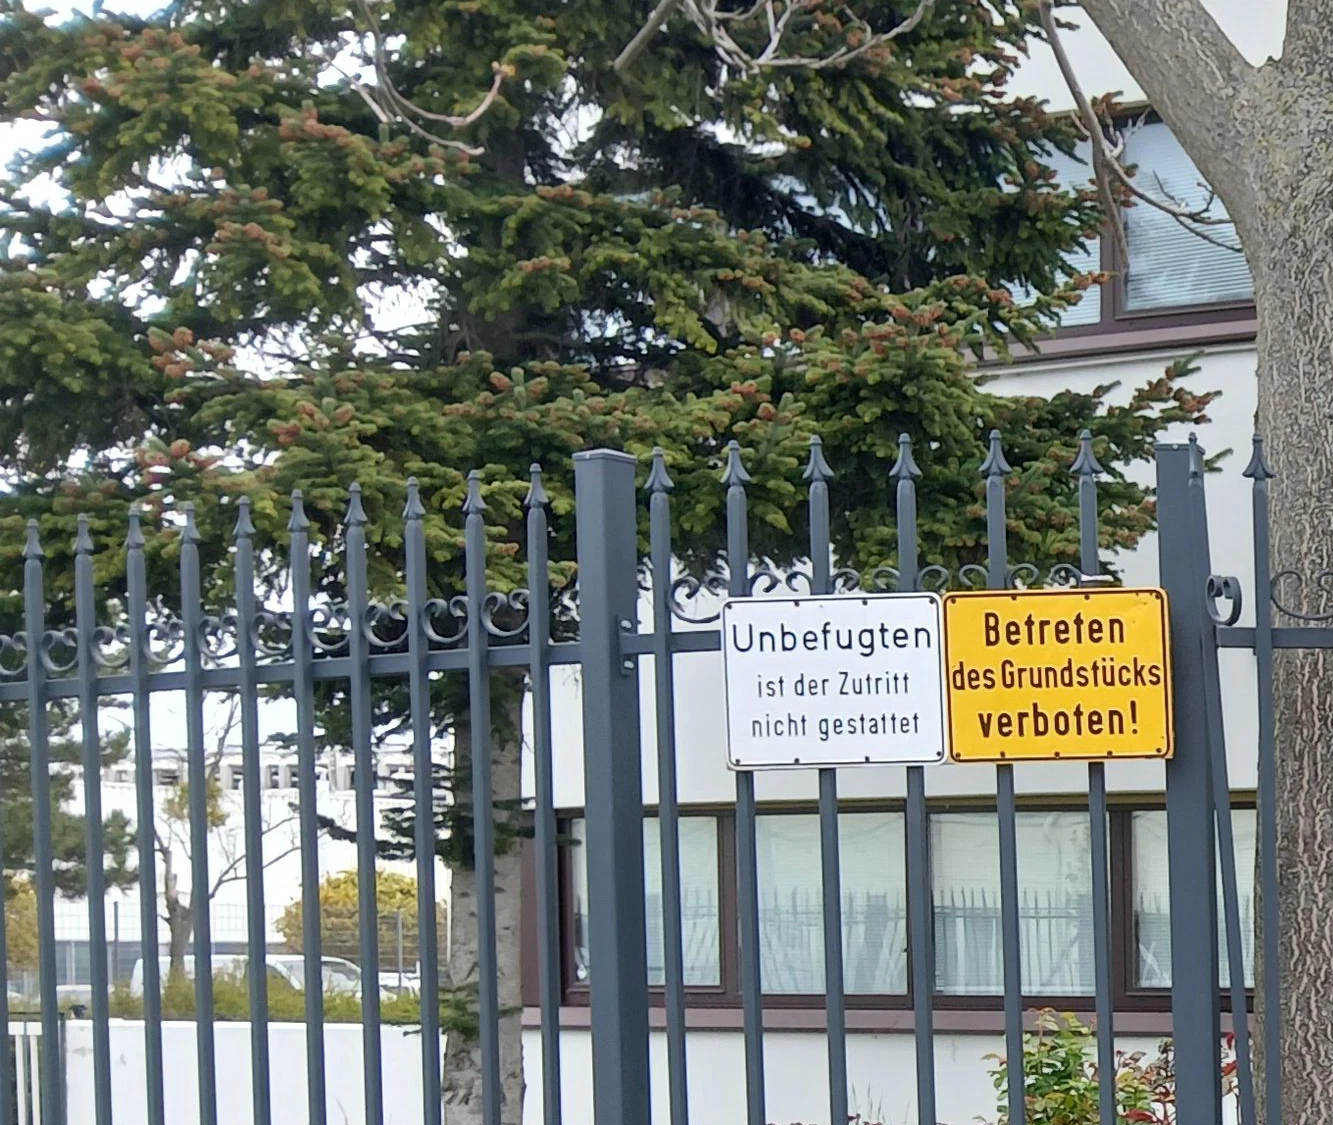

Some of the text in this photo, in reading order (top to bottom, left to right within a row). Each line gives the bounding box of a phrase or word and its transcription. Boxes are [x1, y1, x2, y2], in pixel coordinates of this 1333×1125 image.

[732, 621, 931, 658] Unbefugten
[984, 611, 1125, 647] Betreten
[757, 670, 909, 698] ist der Zutritt
[952, 656, 1161, 691] des Grundstücks
[751, 712, 919, 742] nicht gestattet
[977, 700, 1138, 739] verboten!
